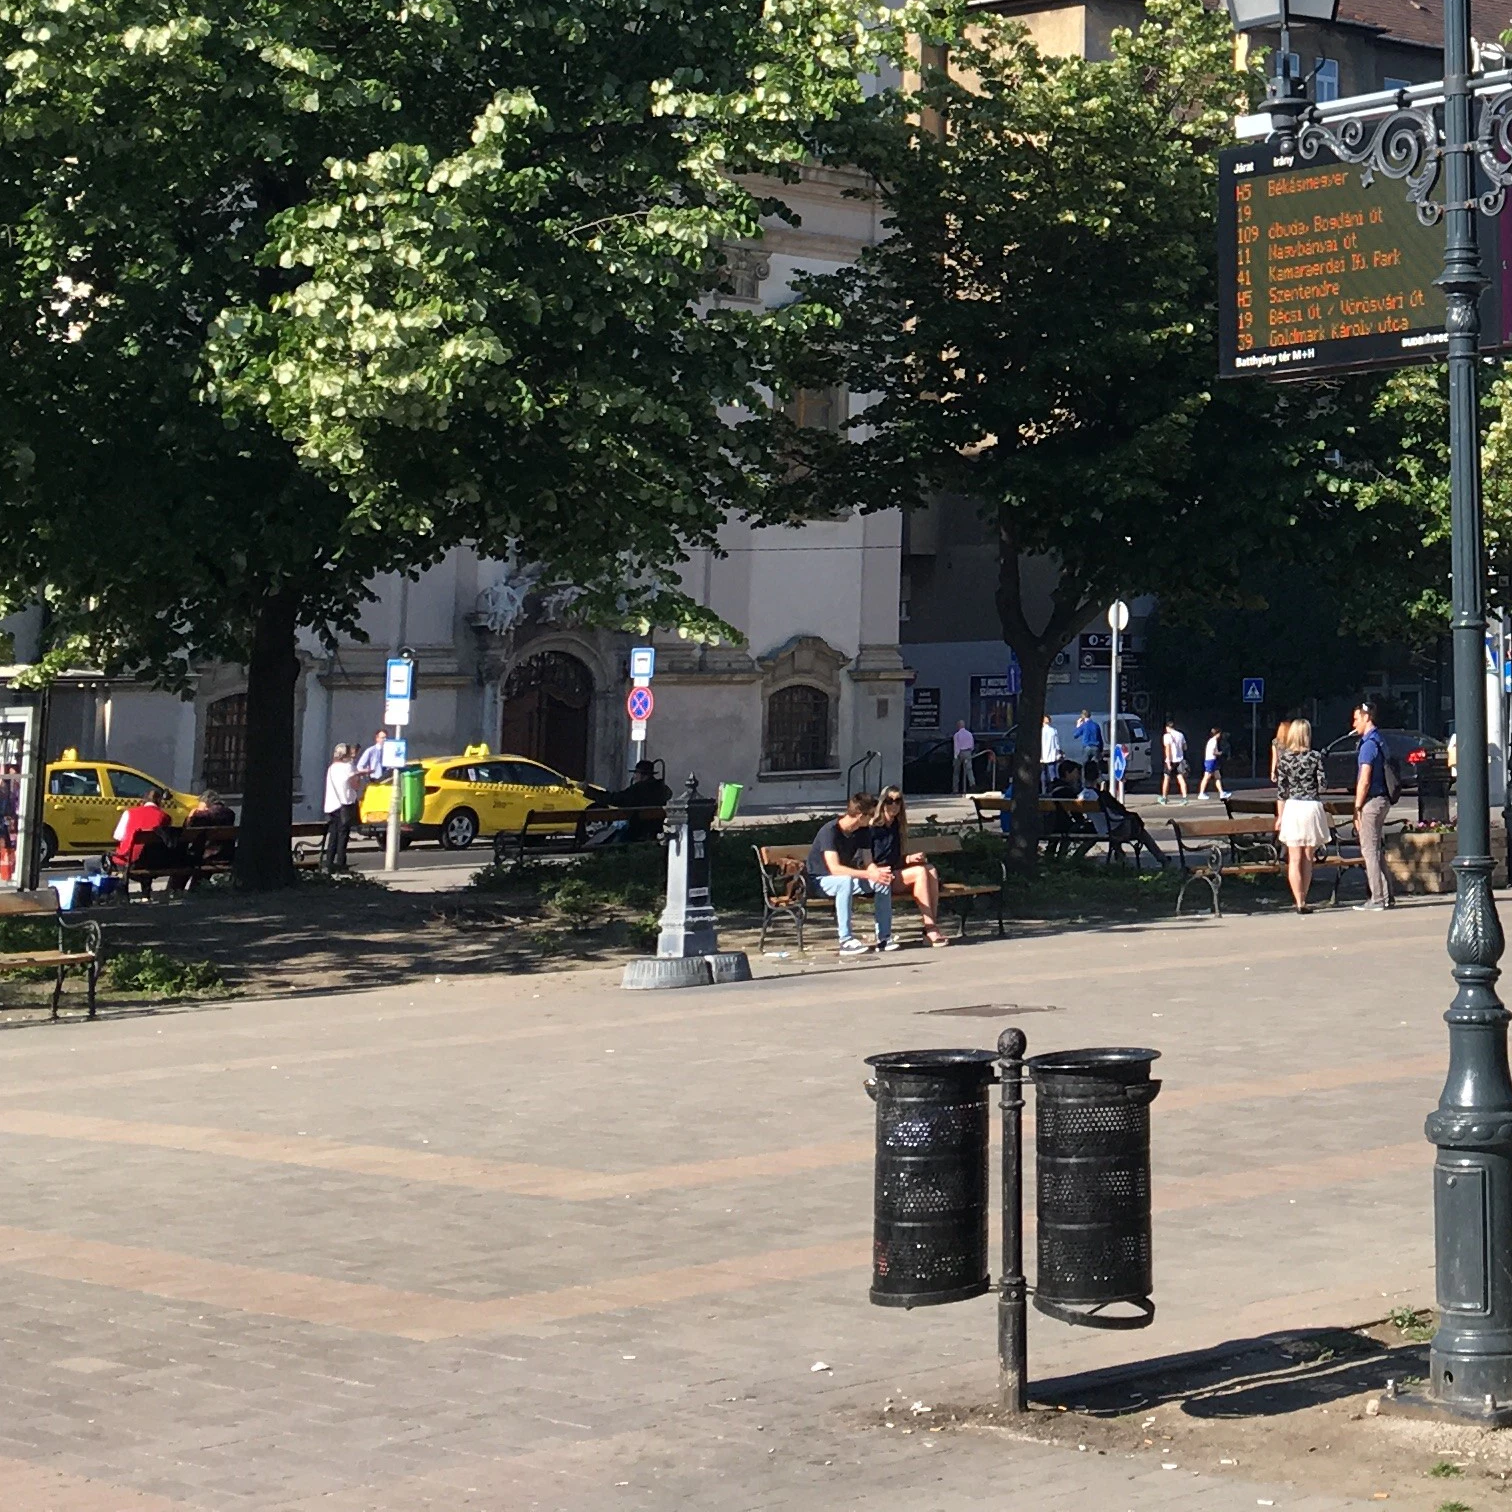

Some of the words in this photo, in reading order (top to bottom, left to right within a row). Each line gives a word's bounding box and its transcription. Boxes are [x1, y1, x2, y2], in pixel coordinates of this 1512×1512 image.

[1233, 161, 1255, 174] Járat
[1273, 155, 1295, 167] Irány
[1235, 183, 1252, 201] H5
[1237, 205, 1252, 223] 19
[1237, 225, 1259, 244] 109
[1237, 248, 1251, 265] 11
[1237, 270, 1251, 285] 41
[1373, 248, 1401, 267] Park
[1237, 290, 1253, 308] H5
[1269, 280, 1339, 303] Szentendre
[1238, 311, 1253, 329] 19
[1269, 308, 1303, 326] Bécsi
[1237, 333, 1253, 351] 39
[1269, 325, 1326, 347] Goldmark
[1377, 315, 1410, 333] utca
[1235, 353, 1277, 368] Batthyány
[1279, 350, 1290, 362] tér
[1292, 348, 1315, 361] M+H
